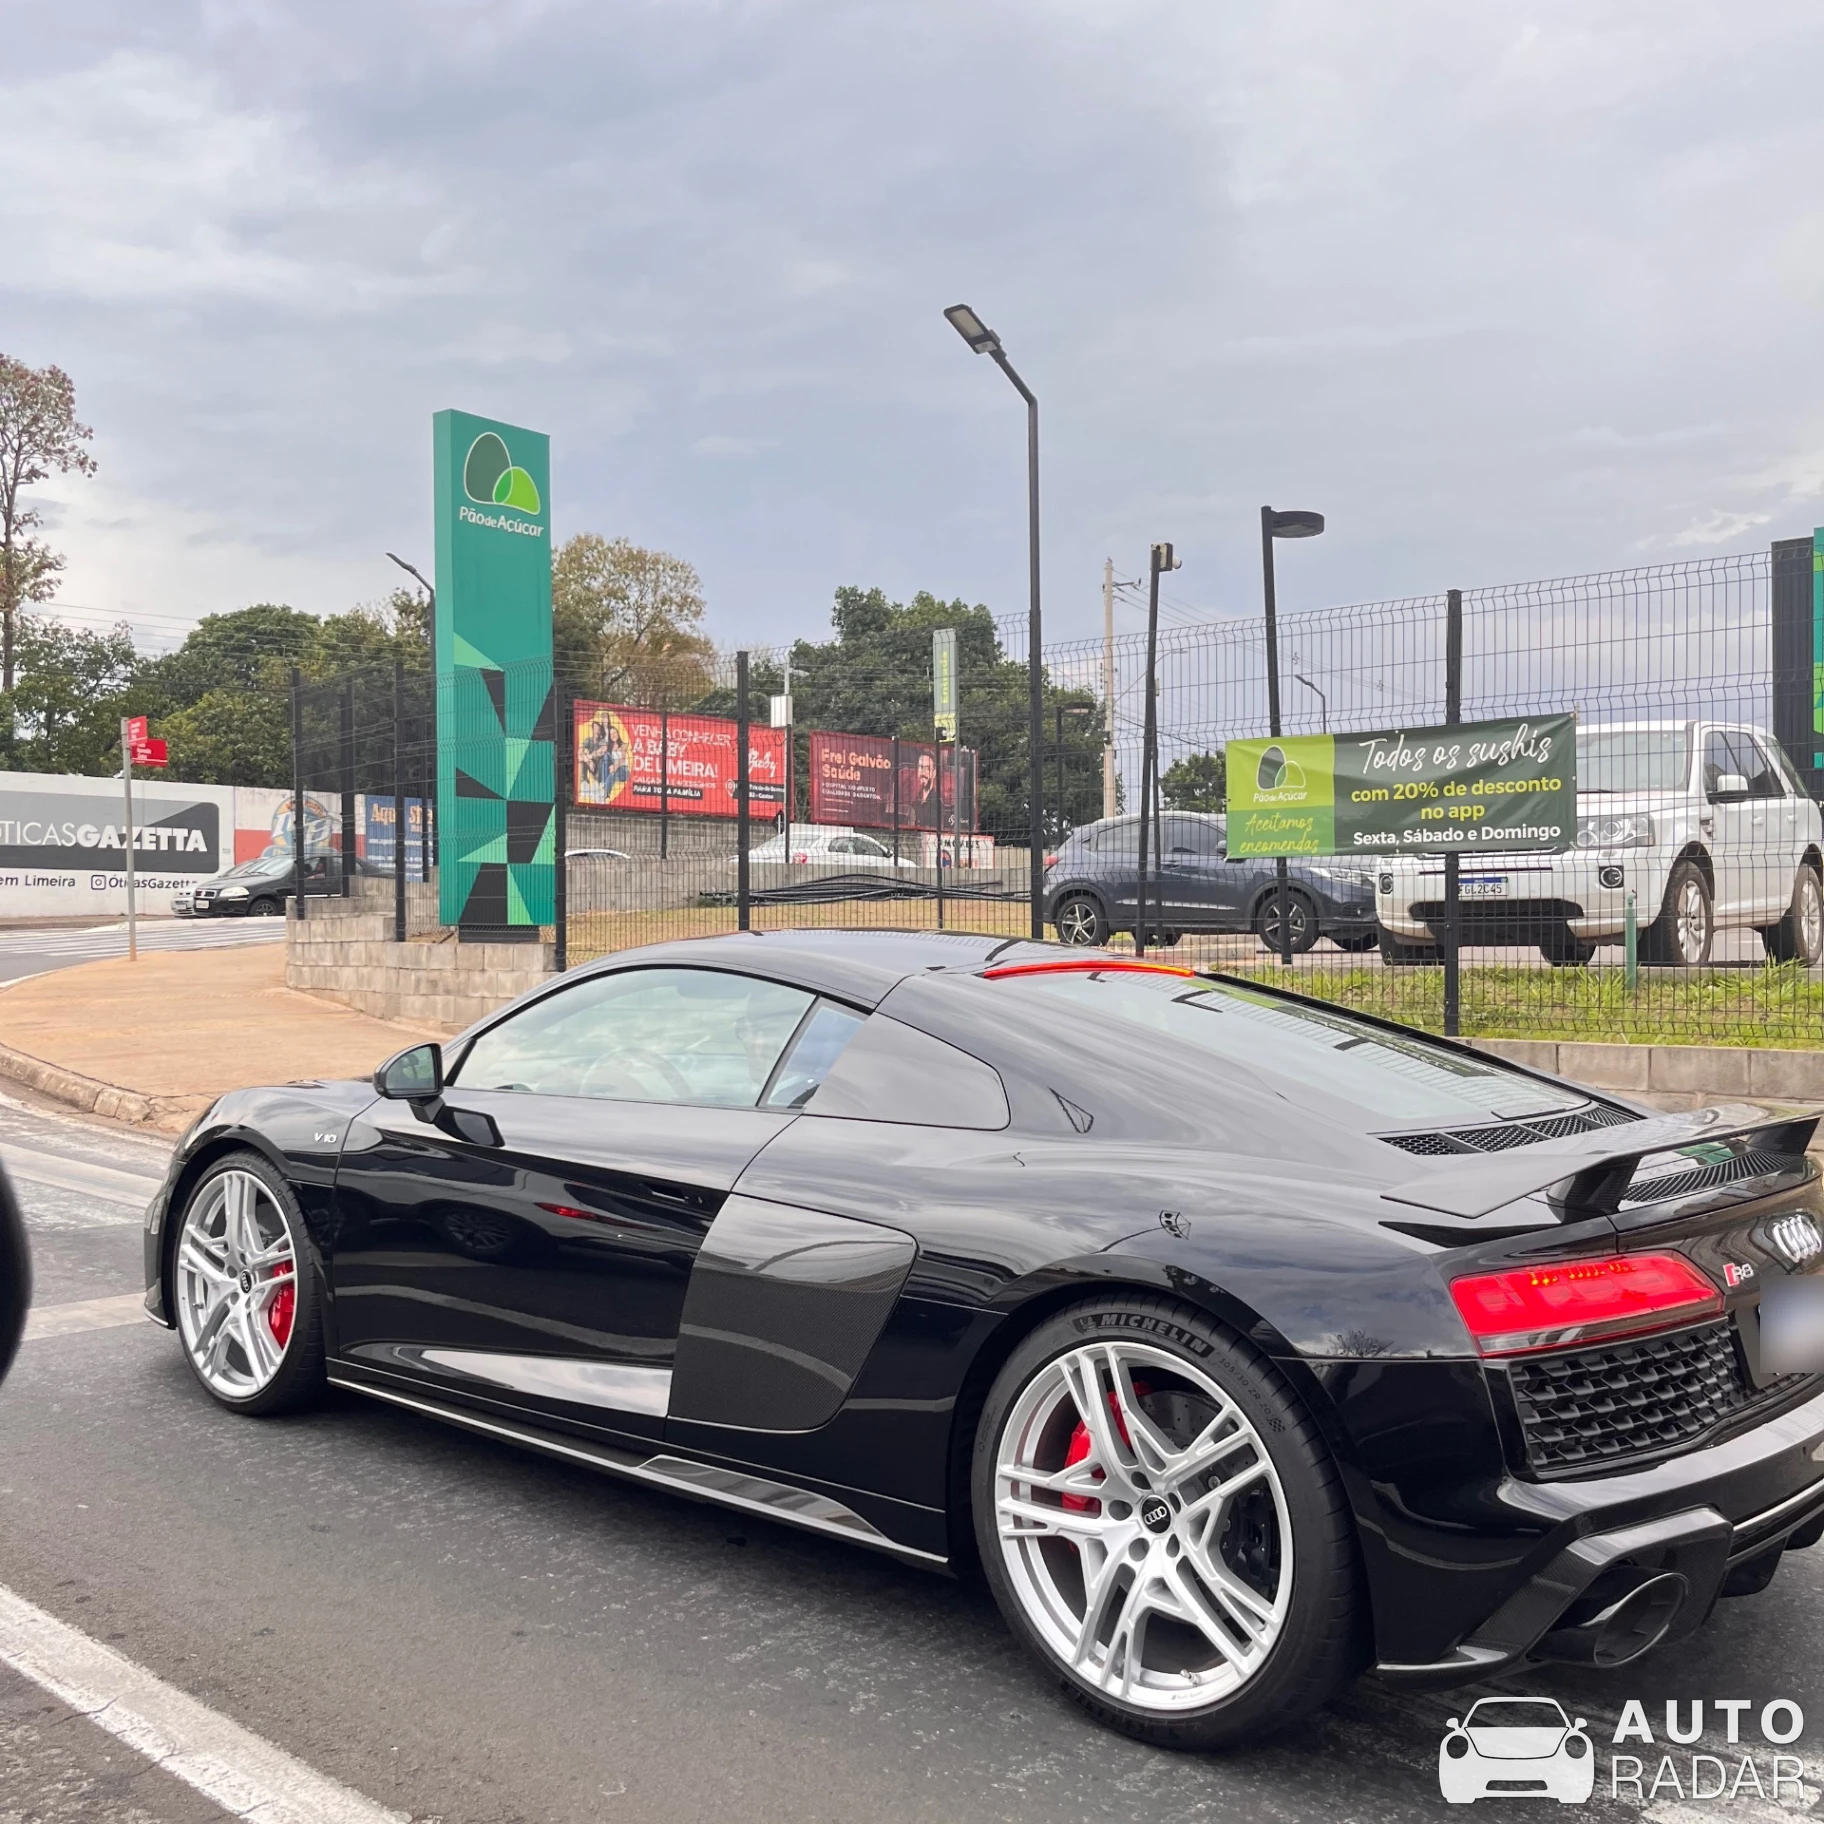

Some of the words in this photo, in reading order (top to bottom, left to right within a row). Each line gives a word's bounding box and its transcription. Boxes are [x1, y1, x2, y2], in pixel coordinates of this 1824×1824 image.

[633, 737, 644, 754] A
[647, 738, 687, 758] BABY
[1358, 733, 1426, 774] Todos
[1432, 743, 1461, 769] os
[1466, 723, 1553, 769] sushis
[633, 757, 653, 773] DE
[822, 748, 847, 765] Frei
[850, 751, 892, 770] Galvão
[821, 764, 861, 782] Saúde
[1351, 787, 1389, 802] com
[1393, 781, 1439, 800] 20%
[1443, 781, 1467, 797] de
[1471, 776, 1562, 795] desconto
[1245, 812, 1313, 836] Aceitamos
[1420, 807, 1444, 820] no
[1448, 804, 1485, 822] app
[1240, 831, 1319, 853] encomendas
[1353, 831, 1399, 846] Sexta,
[1403, 827, 1463, 843] Sábado
[1467, 831, 1477, 841] e
[1481, 824, 1561, 843] Domingo
[25, 875, 76, 887] Limeira
[314, 1132, 337, 1144] V10
[1731, 1262, 1754, 1283] R8
[1101, 1313, 1210, 1355] MICHELIN
[1219, 1358, 1249, 1386] 305/30
